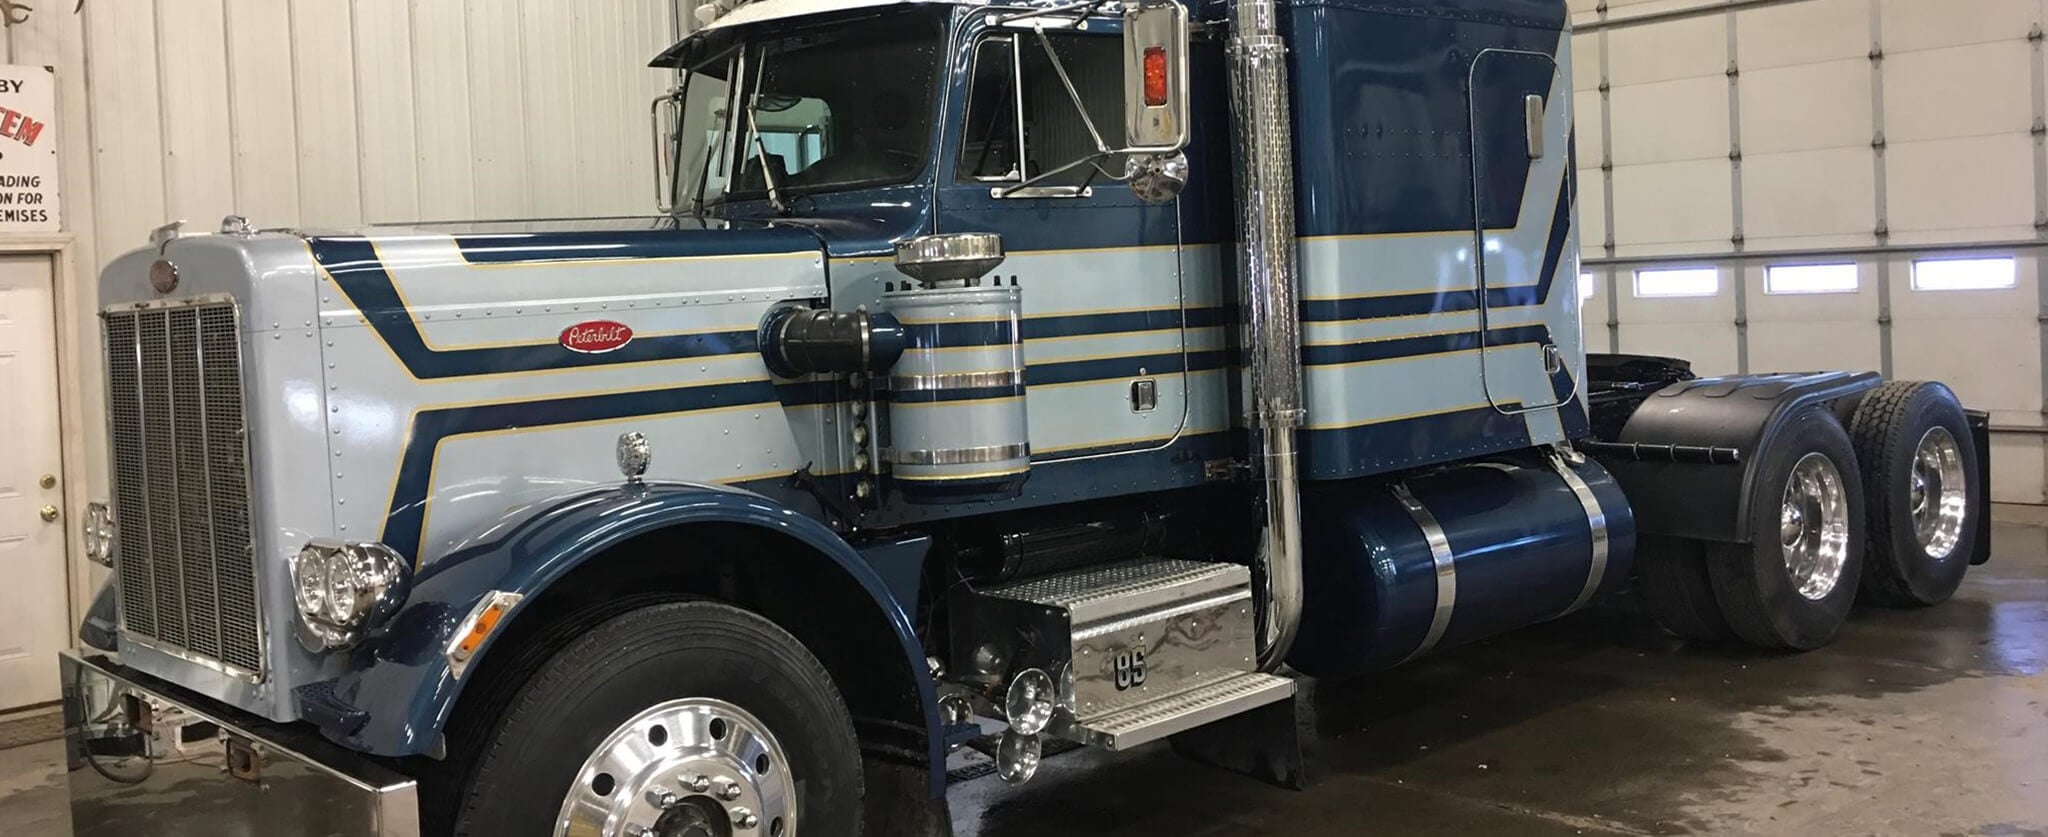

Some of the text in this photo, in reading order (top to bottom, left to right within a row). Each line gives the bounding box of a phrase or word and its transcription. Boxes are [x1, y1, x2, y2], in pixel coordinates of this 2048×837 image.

[17, 192, 43, 205] FOR
[568, 326, 626, 345] Peterbilt
[1114, 645, 1147, 691] 85
